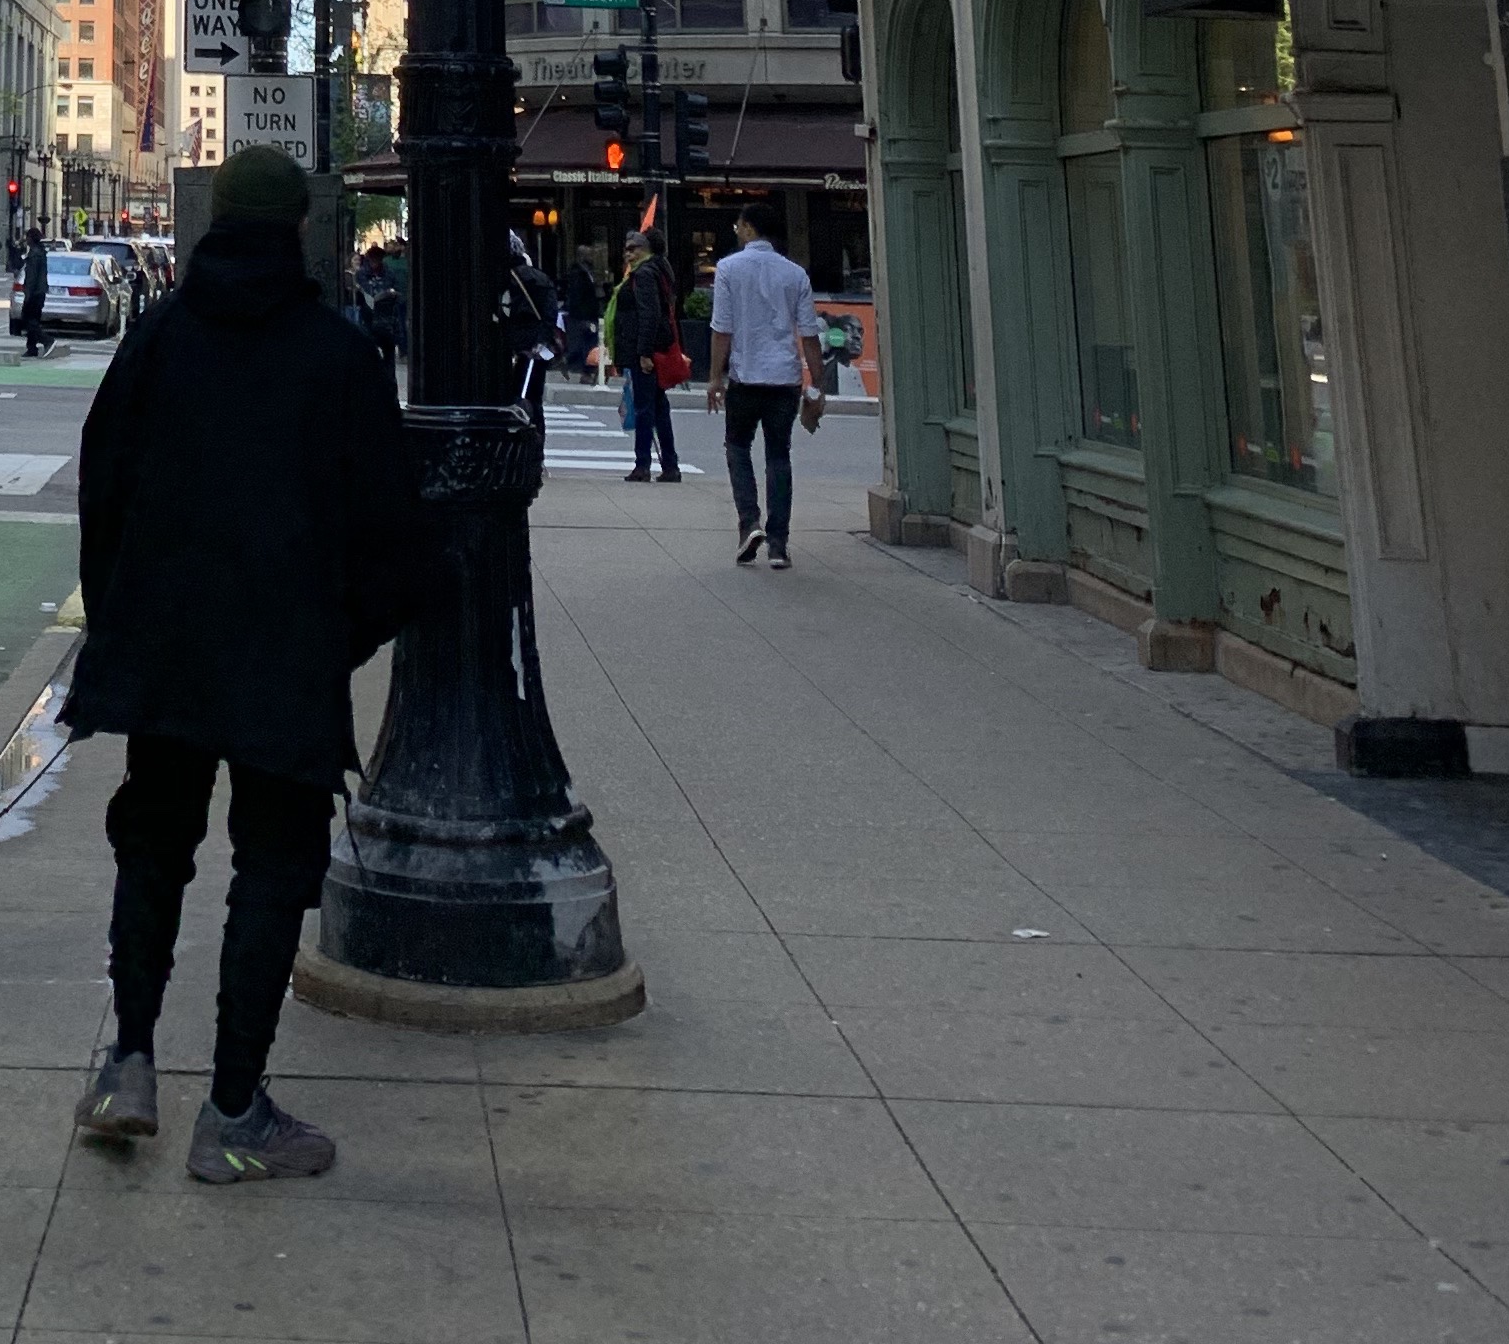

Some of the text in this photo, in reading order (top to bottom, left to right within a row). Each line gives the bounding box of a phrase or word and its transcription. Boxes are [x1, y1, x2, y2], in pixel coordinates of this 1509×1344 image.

[192, 14, 240, 37] WAY
[253, 87, 286, 105] NO
[243, 113, 297, 132] TURN
[552, 170, 587, 183] Classic
